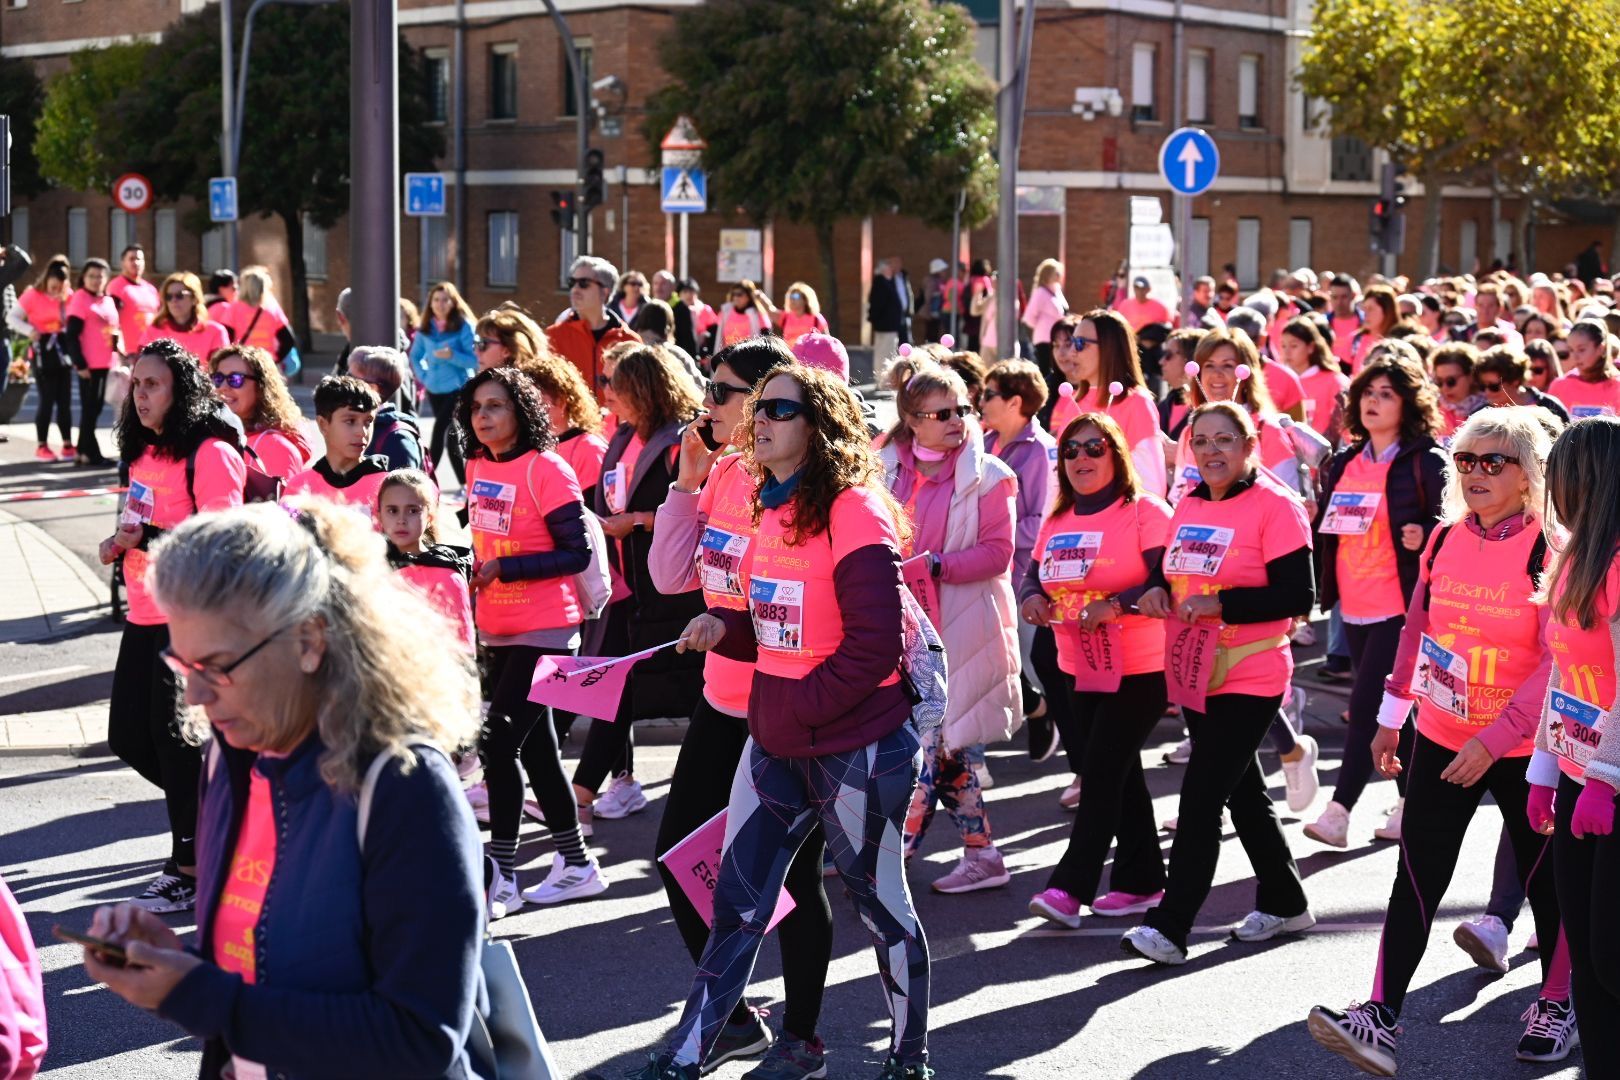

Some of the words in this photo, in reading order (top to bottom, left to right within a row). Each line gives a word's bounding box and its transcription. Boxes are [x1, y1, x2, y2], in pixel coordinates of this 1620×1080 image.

[123, 187, 144, 201] 30
[483, 498, 506, 512] 3609
[1059, 548, 1086, 561] 2133
[1188, 542, 1218, 555] 4480
[708, 551, 733, 571] 3906
[1440, 576, 1511, 603] Drasanvi
[1474, 604, 1521, 616] CAROBELS
[1189, 628, 1210, 690] Ezedent
[1434, 665, 1455, 689] 5123
